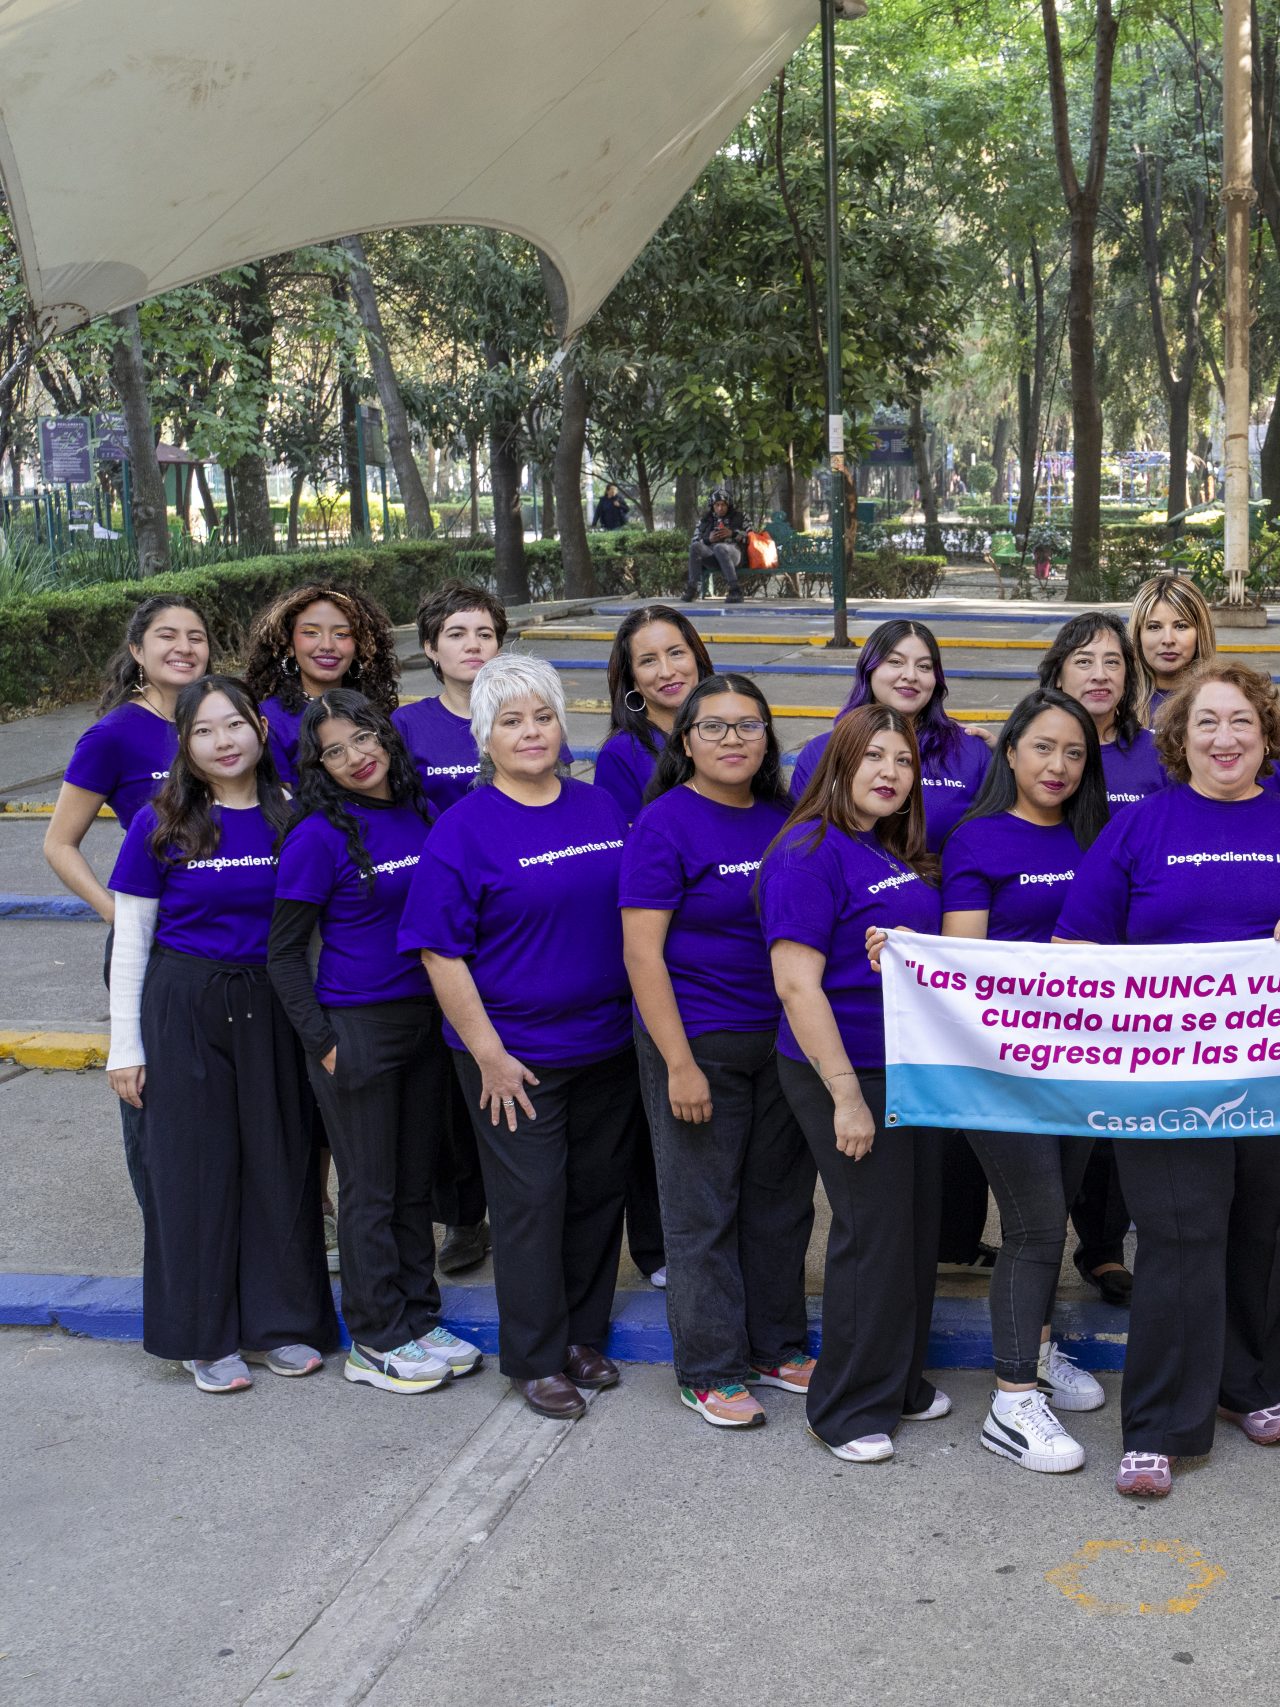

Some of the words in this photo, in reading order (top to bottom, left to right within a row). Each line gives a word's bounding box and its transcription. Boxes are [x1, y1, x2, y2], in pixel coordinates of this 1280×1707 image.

[944, 777, 966, 788] Inc.
[518, 841, 607, 867] Desobedientes
[607, 839, 623, 849] Inc
[1167, 851, 1274, 866] Desobedientes
[904, 959, 967, 991] "Las
[975, 971, 1116, 1001] gaviotas
[1125, 973, 1236, 999] NUNCA
[981, 1007, 1103, 1032] cuando
[1111, 1013, 1173, 1033] una
[1181, 1012, 1217, 1032] se
[999, 1043, 1123, 1071] regresa
[1129, 1047, 1185, 1073] por
[1192, 1041, 1238, 1065] las
